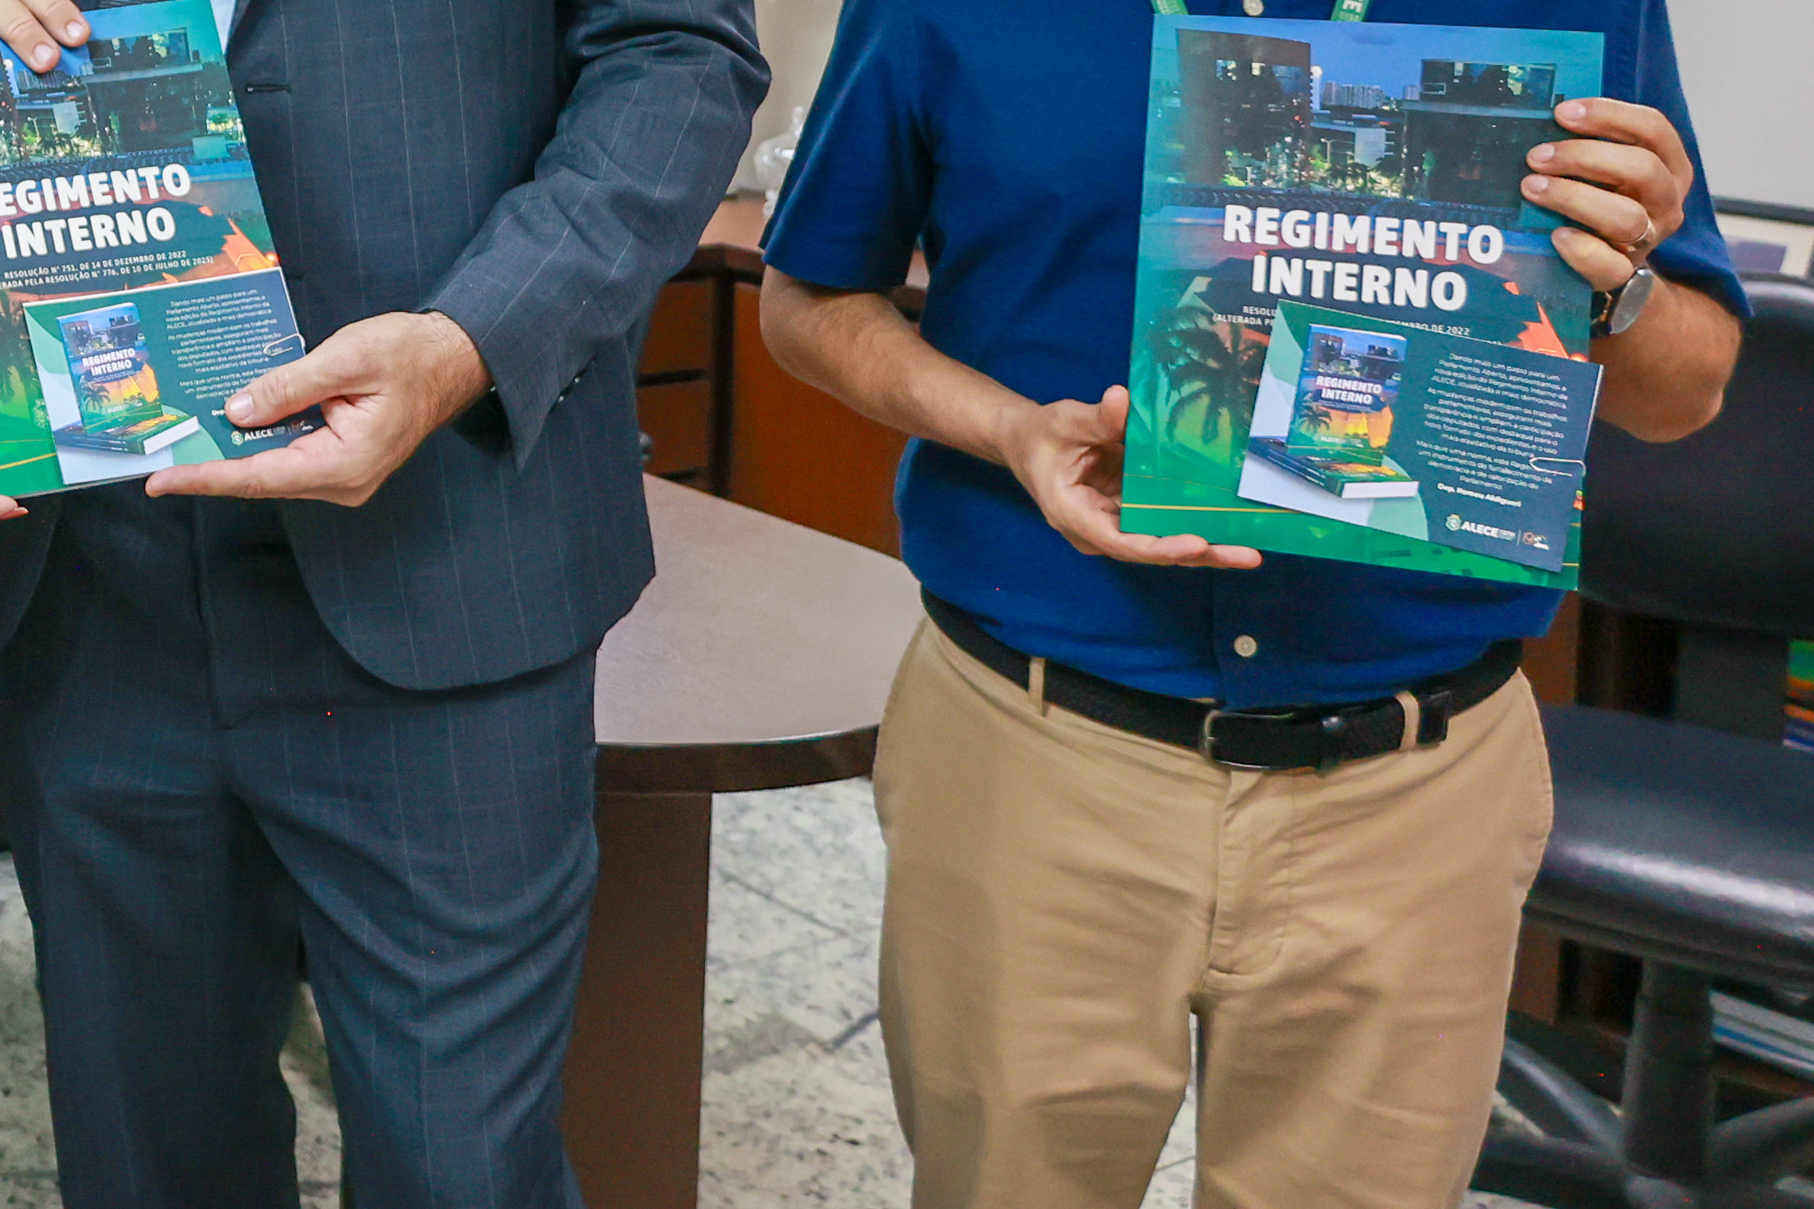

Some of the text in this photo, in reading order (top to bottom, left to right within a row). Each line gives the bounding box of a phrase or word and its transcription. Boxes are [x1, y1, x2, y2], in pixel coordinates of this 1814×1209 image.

[1, 207, 176, 259] INTERNO
[1223, 204, 1504, 264] REGIMENTO
[4, 267, 49, 279] RESOLUÇÃO
[79, 262, 90, 270] DE
[92, 261, 101, 269] 14
[102, 259, 113, 267] DE
[114, 254, 155, 266] DEZEMBRO
[156, 253, 166, 261] DE
[168, 250, 186, 259] 2022
[25, 278, 44, 286] PELA
[45, 271, 90, 283] RESOLUÇÃO
[132, 265, 141, 273] 10
[143, 264, 153, 272] DE
[155, 260, 179, 270] JULHO
[181, 259, 191, 267] DE
[1251, 254, 1467, 311] INTERNO
[1446, 326, 1469, 336] 2022
[82, 348, 136, 367] REGIMENTO
[91, 360, 132, 376] INTERNO
[1316, 375, 1383, 394] REGIMENTO
[1321, 389, 1373, 405] INTERNO
[244, 427, 274, 441] ALECE
[1461, 521, 1499, 538] ALECE
